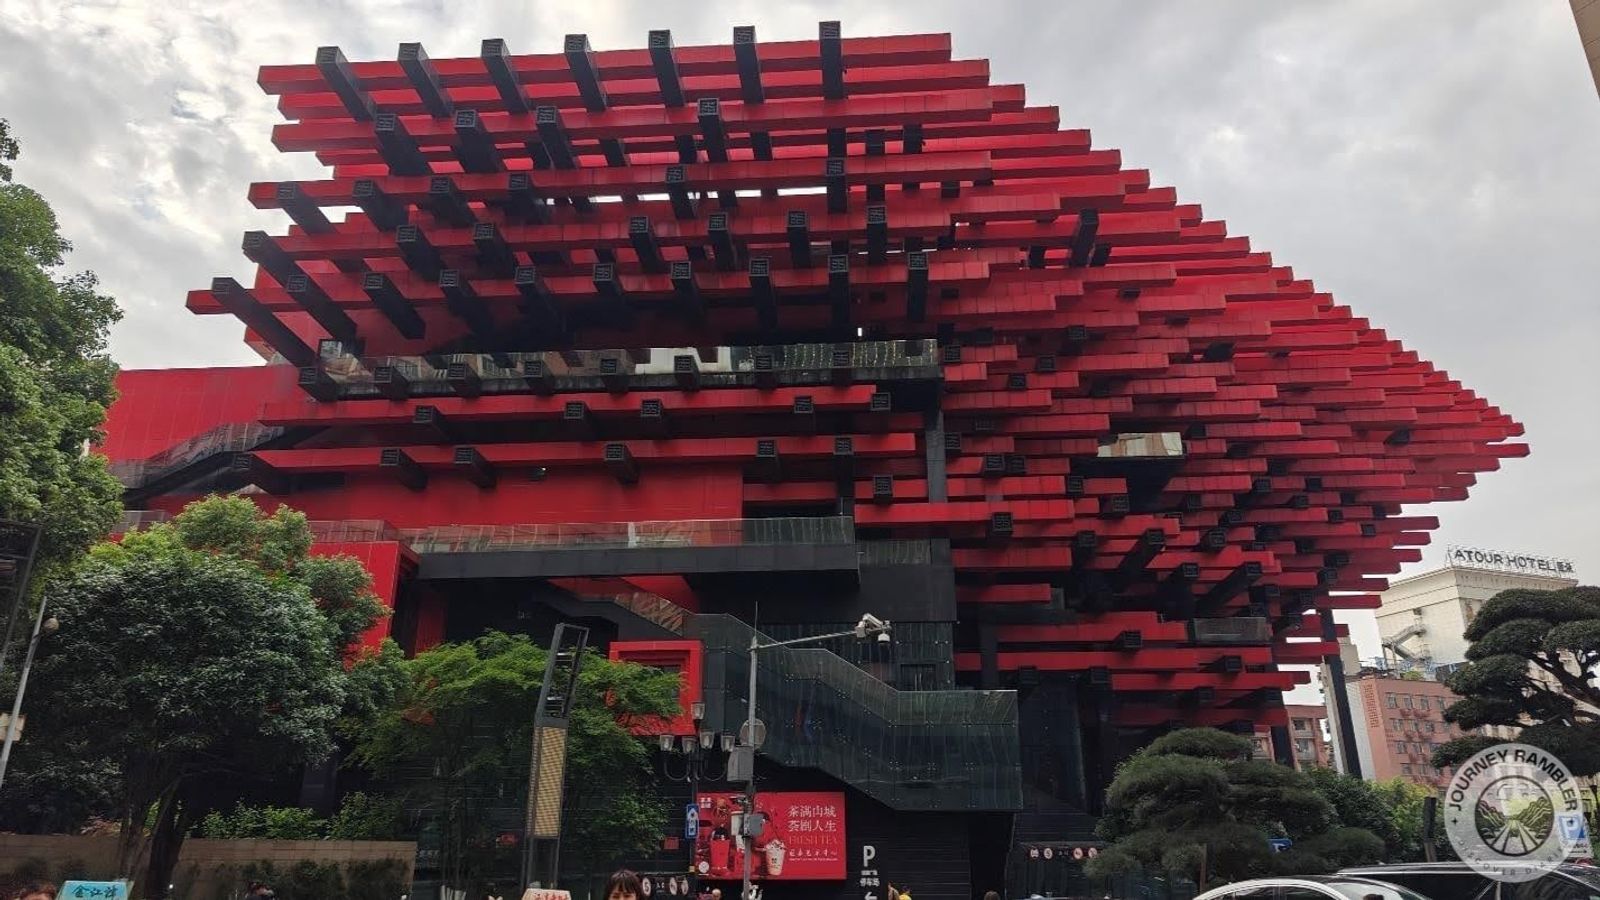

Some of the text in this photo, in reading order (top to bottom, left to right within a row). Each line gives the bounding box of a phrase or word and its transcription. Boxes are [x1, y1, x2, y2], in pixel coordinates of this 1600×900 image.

[1454, 550, 1503, 564] ATOUR
[1508, 556, 1556, 571] HOTEL
[789, 835, 838, 845] FRESH TEA
[863, 845, 876, 868] P
